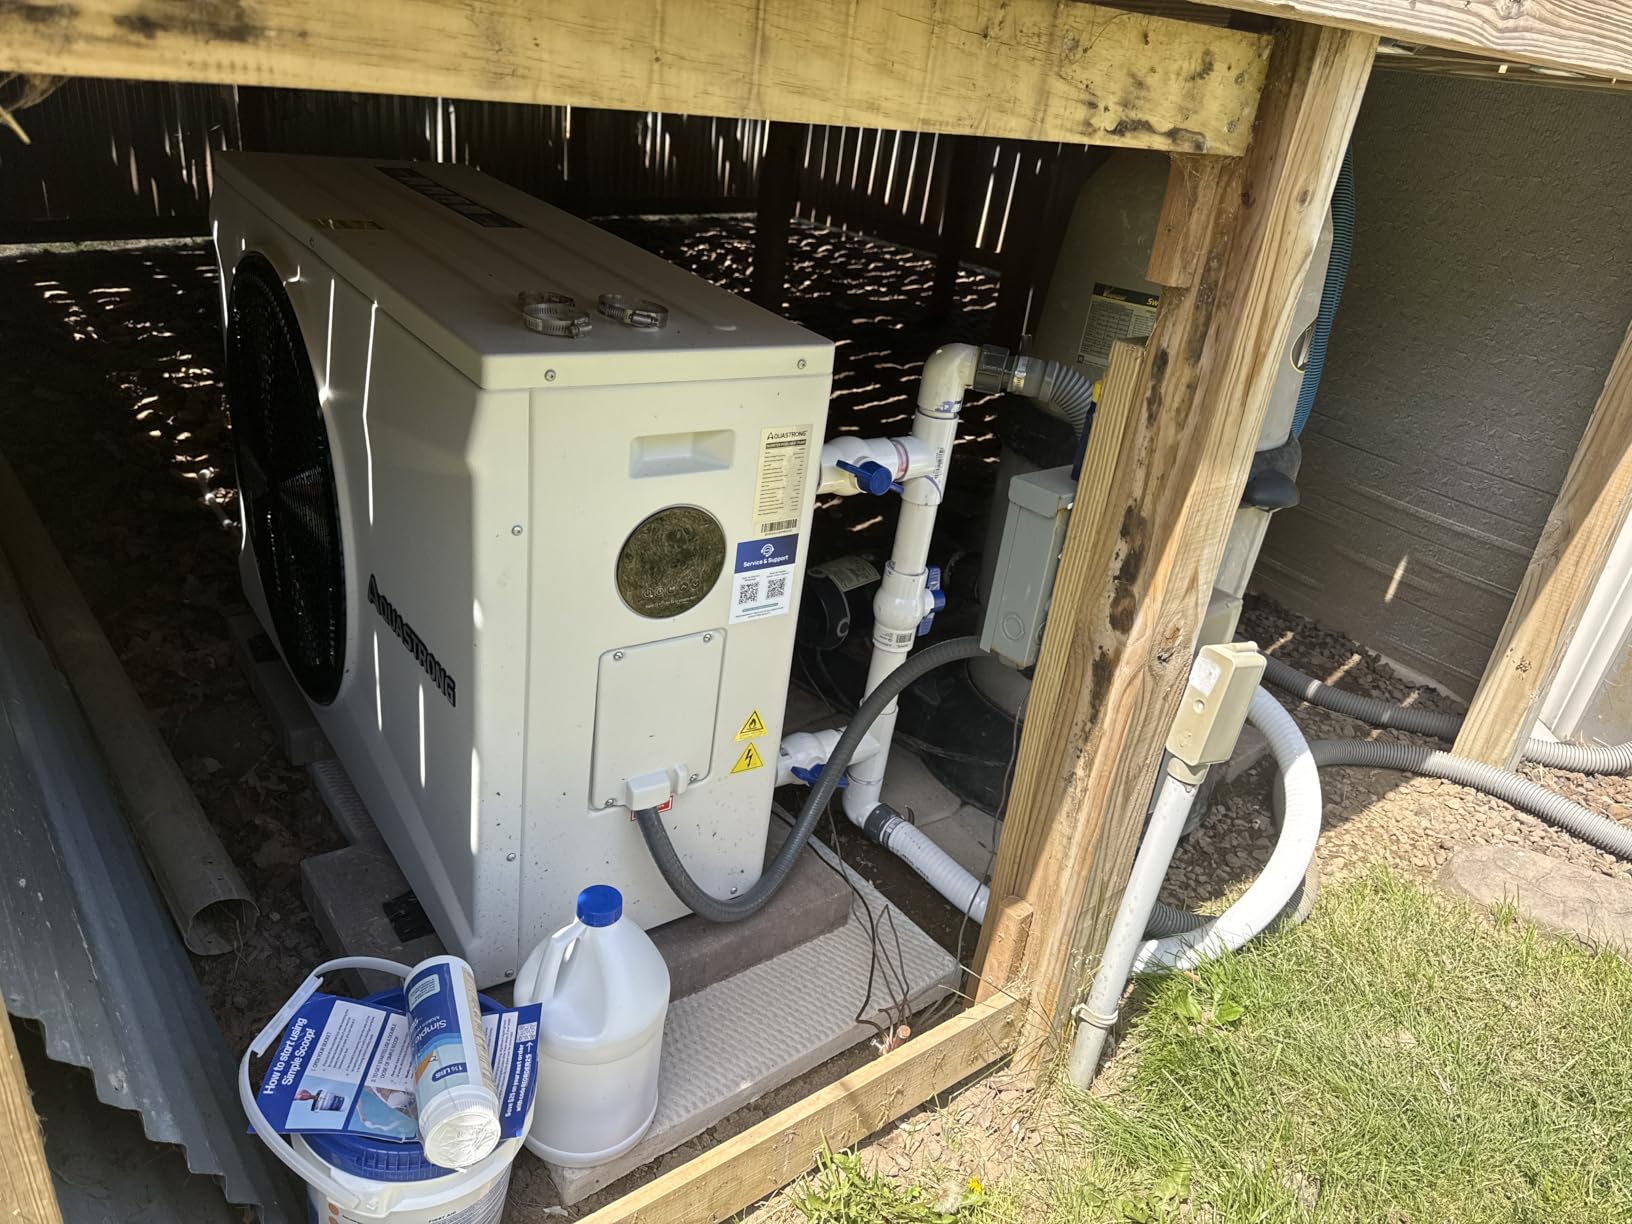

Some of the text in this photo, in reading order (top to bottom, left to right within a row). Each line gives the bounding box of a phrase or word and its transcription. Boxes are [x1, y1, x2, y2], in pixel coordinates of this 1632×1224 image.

[766, 430, 807, 440] AQUASTRONG
[743, 559, 763, 568] Service
[768, 554, 789, 564] Support
[367, 573, 456, 708] AQUASTRONG
[263, 1017, 308, 1094] How to start using
[281, 1027, 316, 1085] Simple Scoop!
[517, 1044, 525, 1061] order
